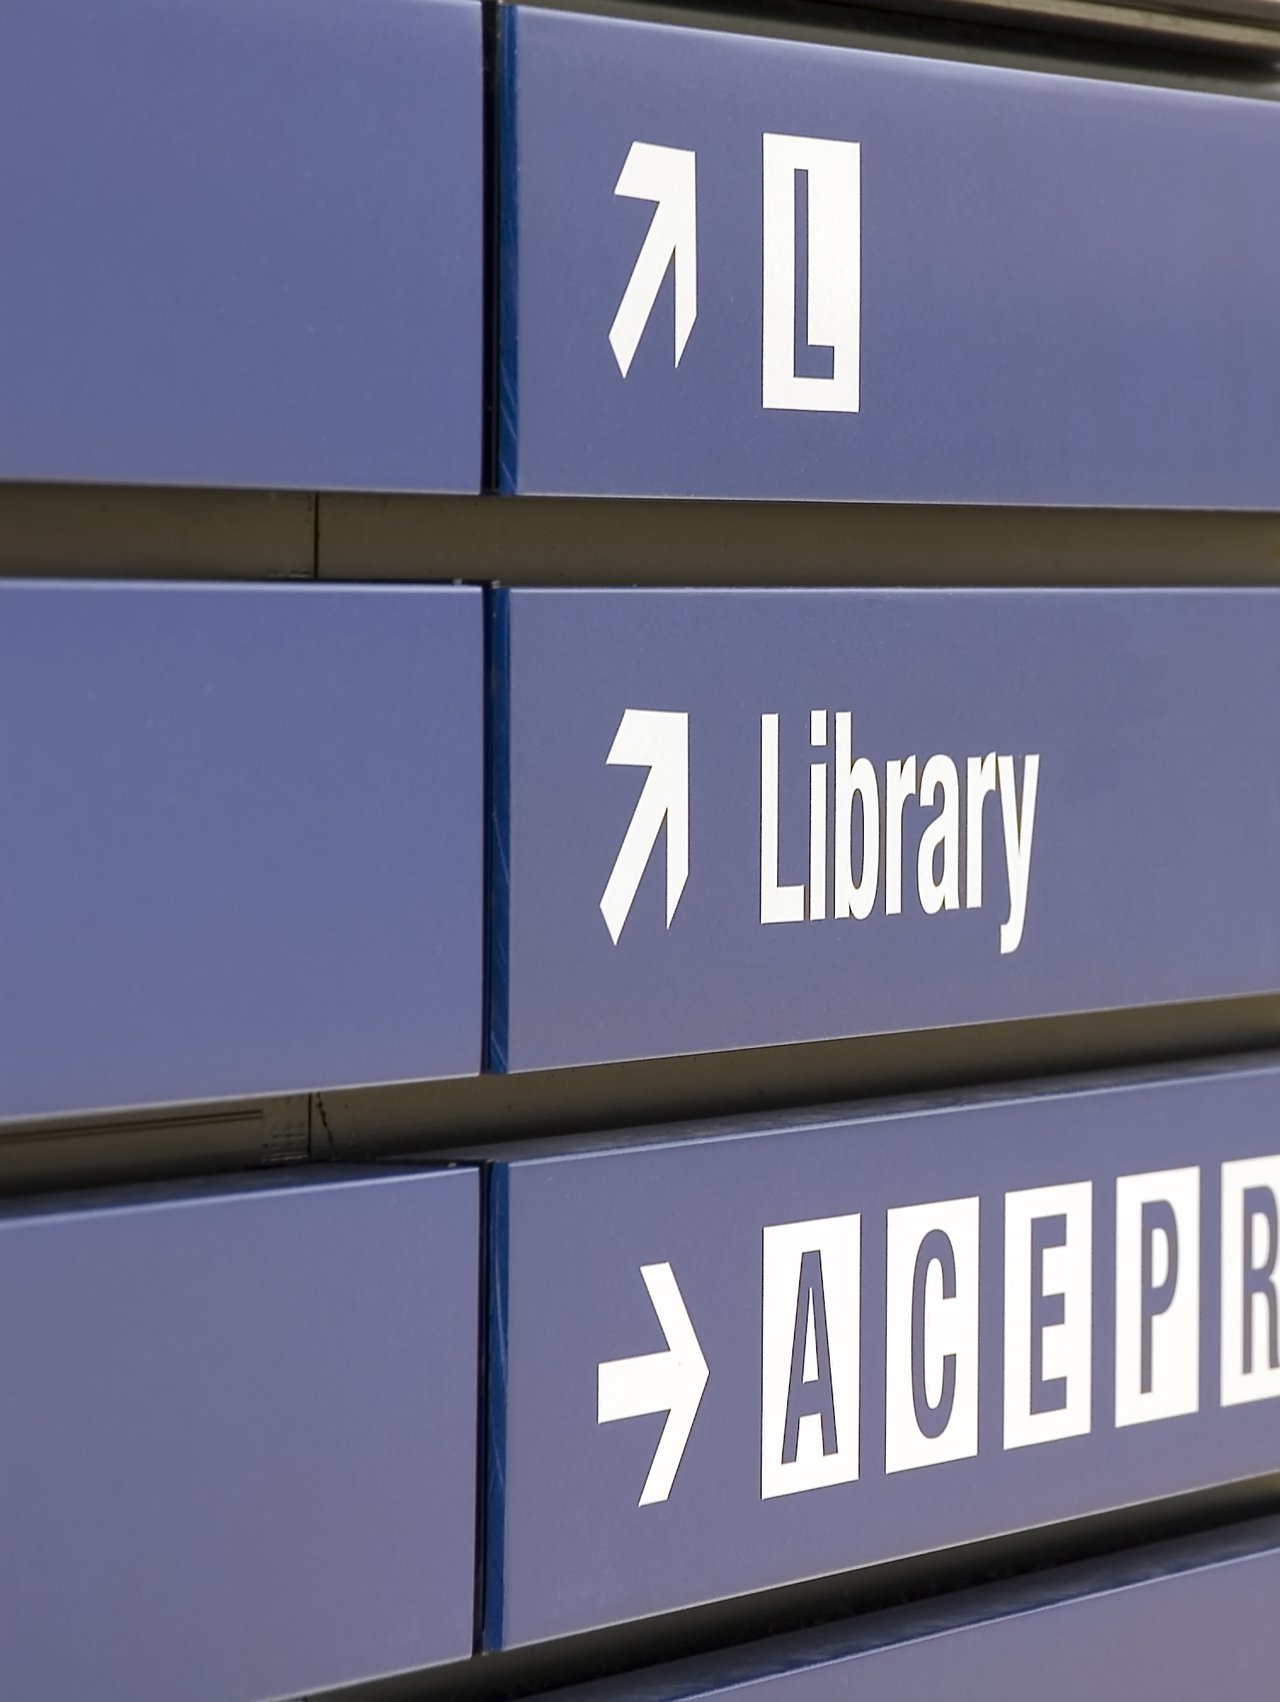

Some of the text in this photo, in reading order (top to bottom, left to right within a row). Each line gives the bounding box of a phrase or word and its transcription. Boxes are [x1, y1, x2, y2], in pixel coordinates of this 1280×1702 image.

[792, 167, 836, 381] L
[760, 709, 1040, 955] Library
[780, 1185, 1280, 1466] A C E P R
